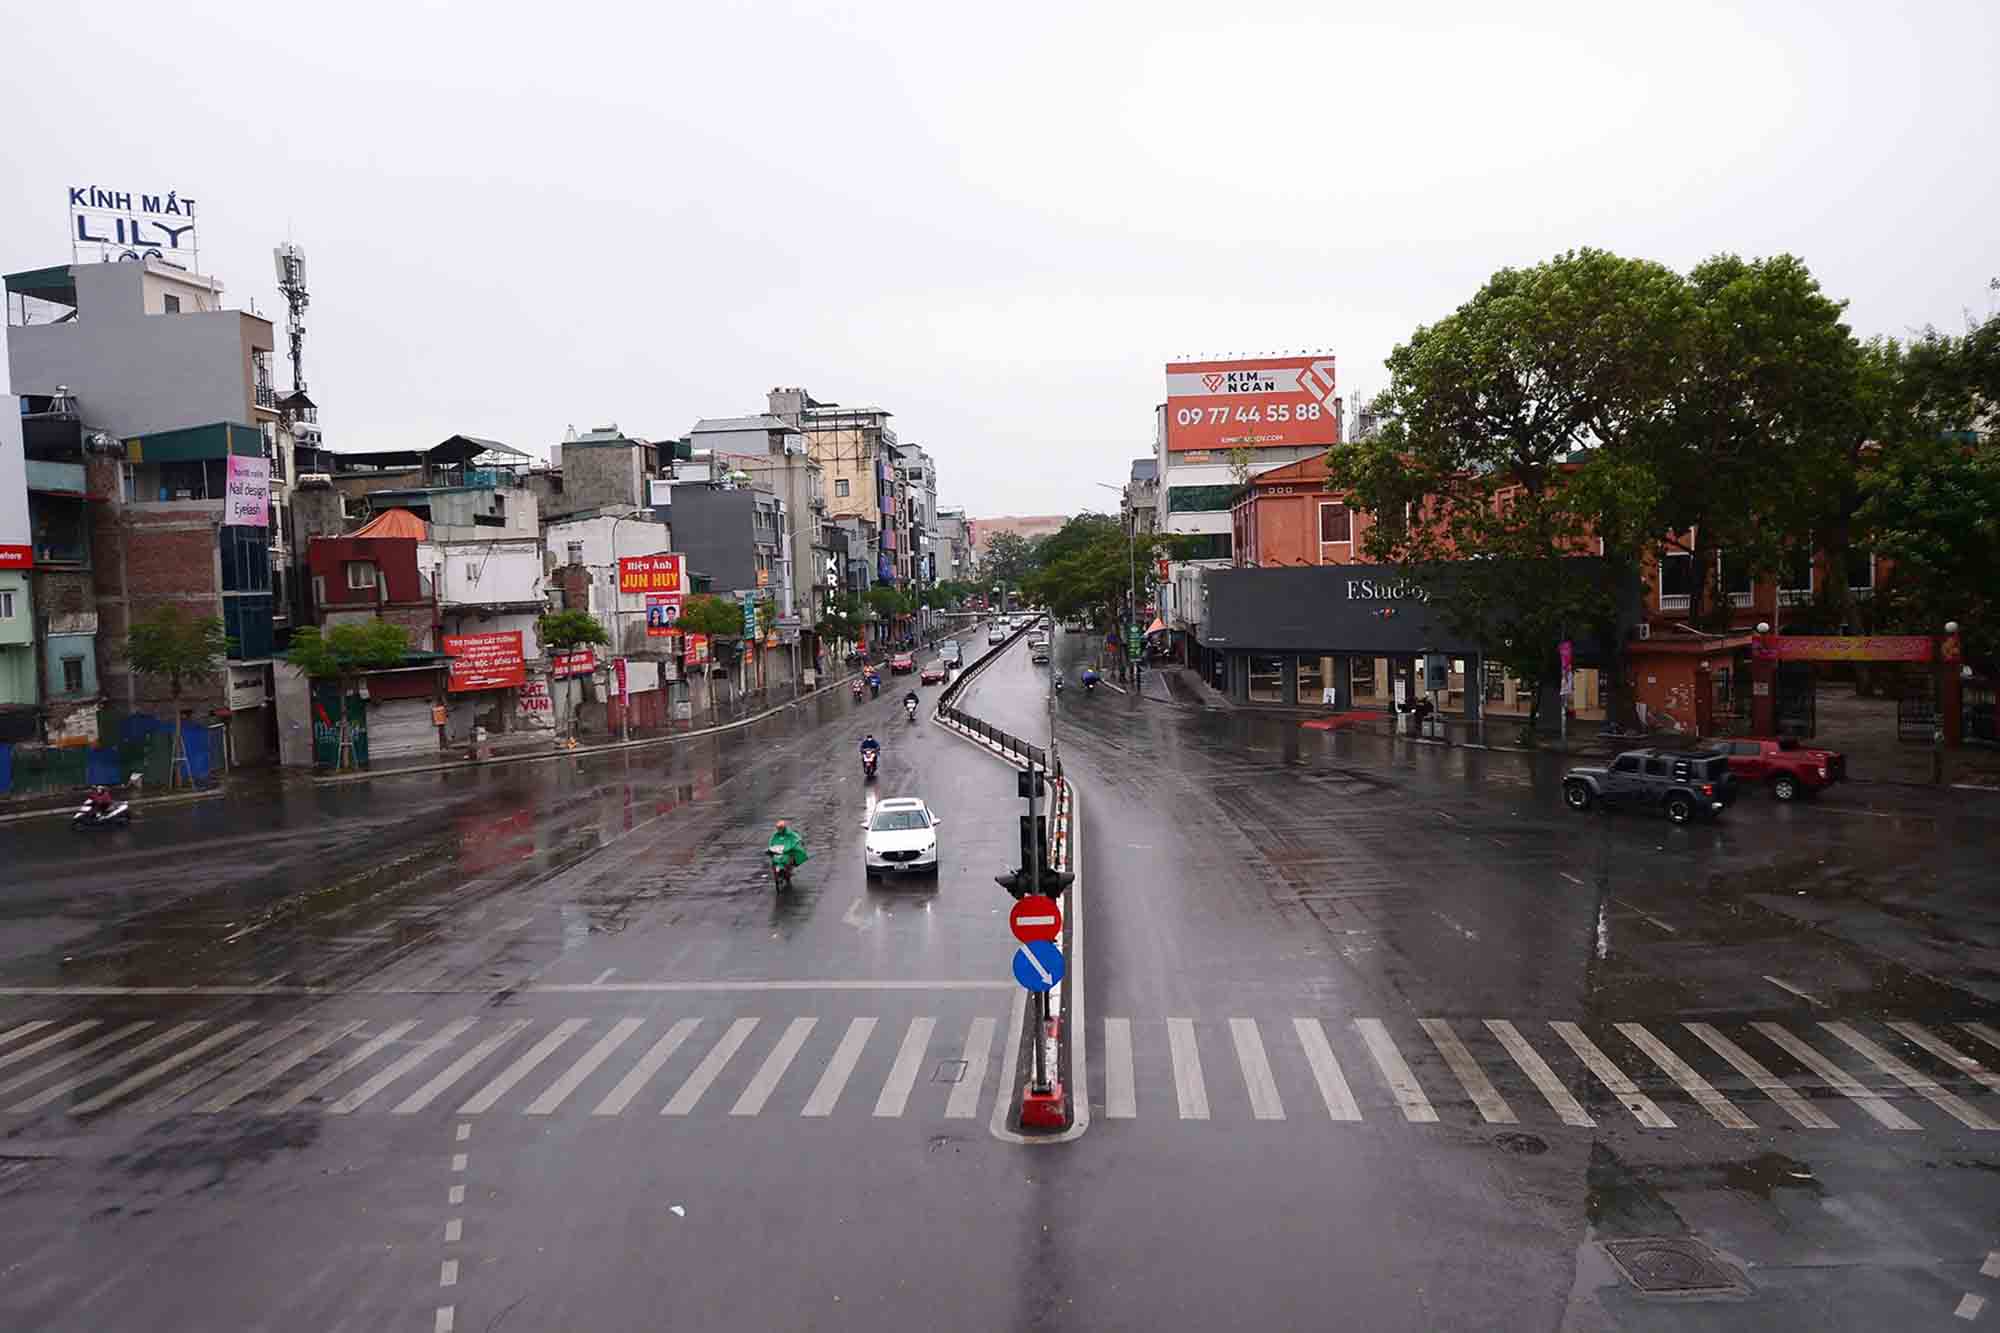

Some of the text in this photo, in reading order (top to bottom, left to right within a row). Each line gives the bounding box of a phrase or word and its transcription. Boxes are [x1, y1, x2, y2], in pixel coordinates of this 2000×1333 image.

[69, 184, 195, 217] KÍNH MẮT
[77, 215, 194, 249] LILY
[1228, 372, 1258, 382] KIM
[1228, 382, 1275, 393] NGAN
[1177, 403, 1321, 425] 09 77 44 55 88
[622, 572, 678, 588] JUN HUY
